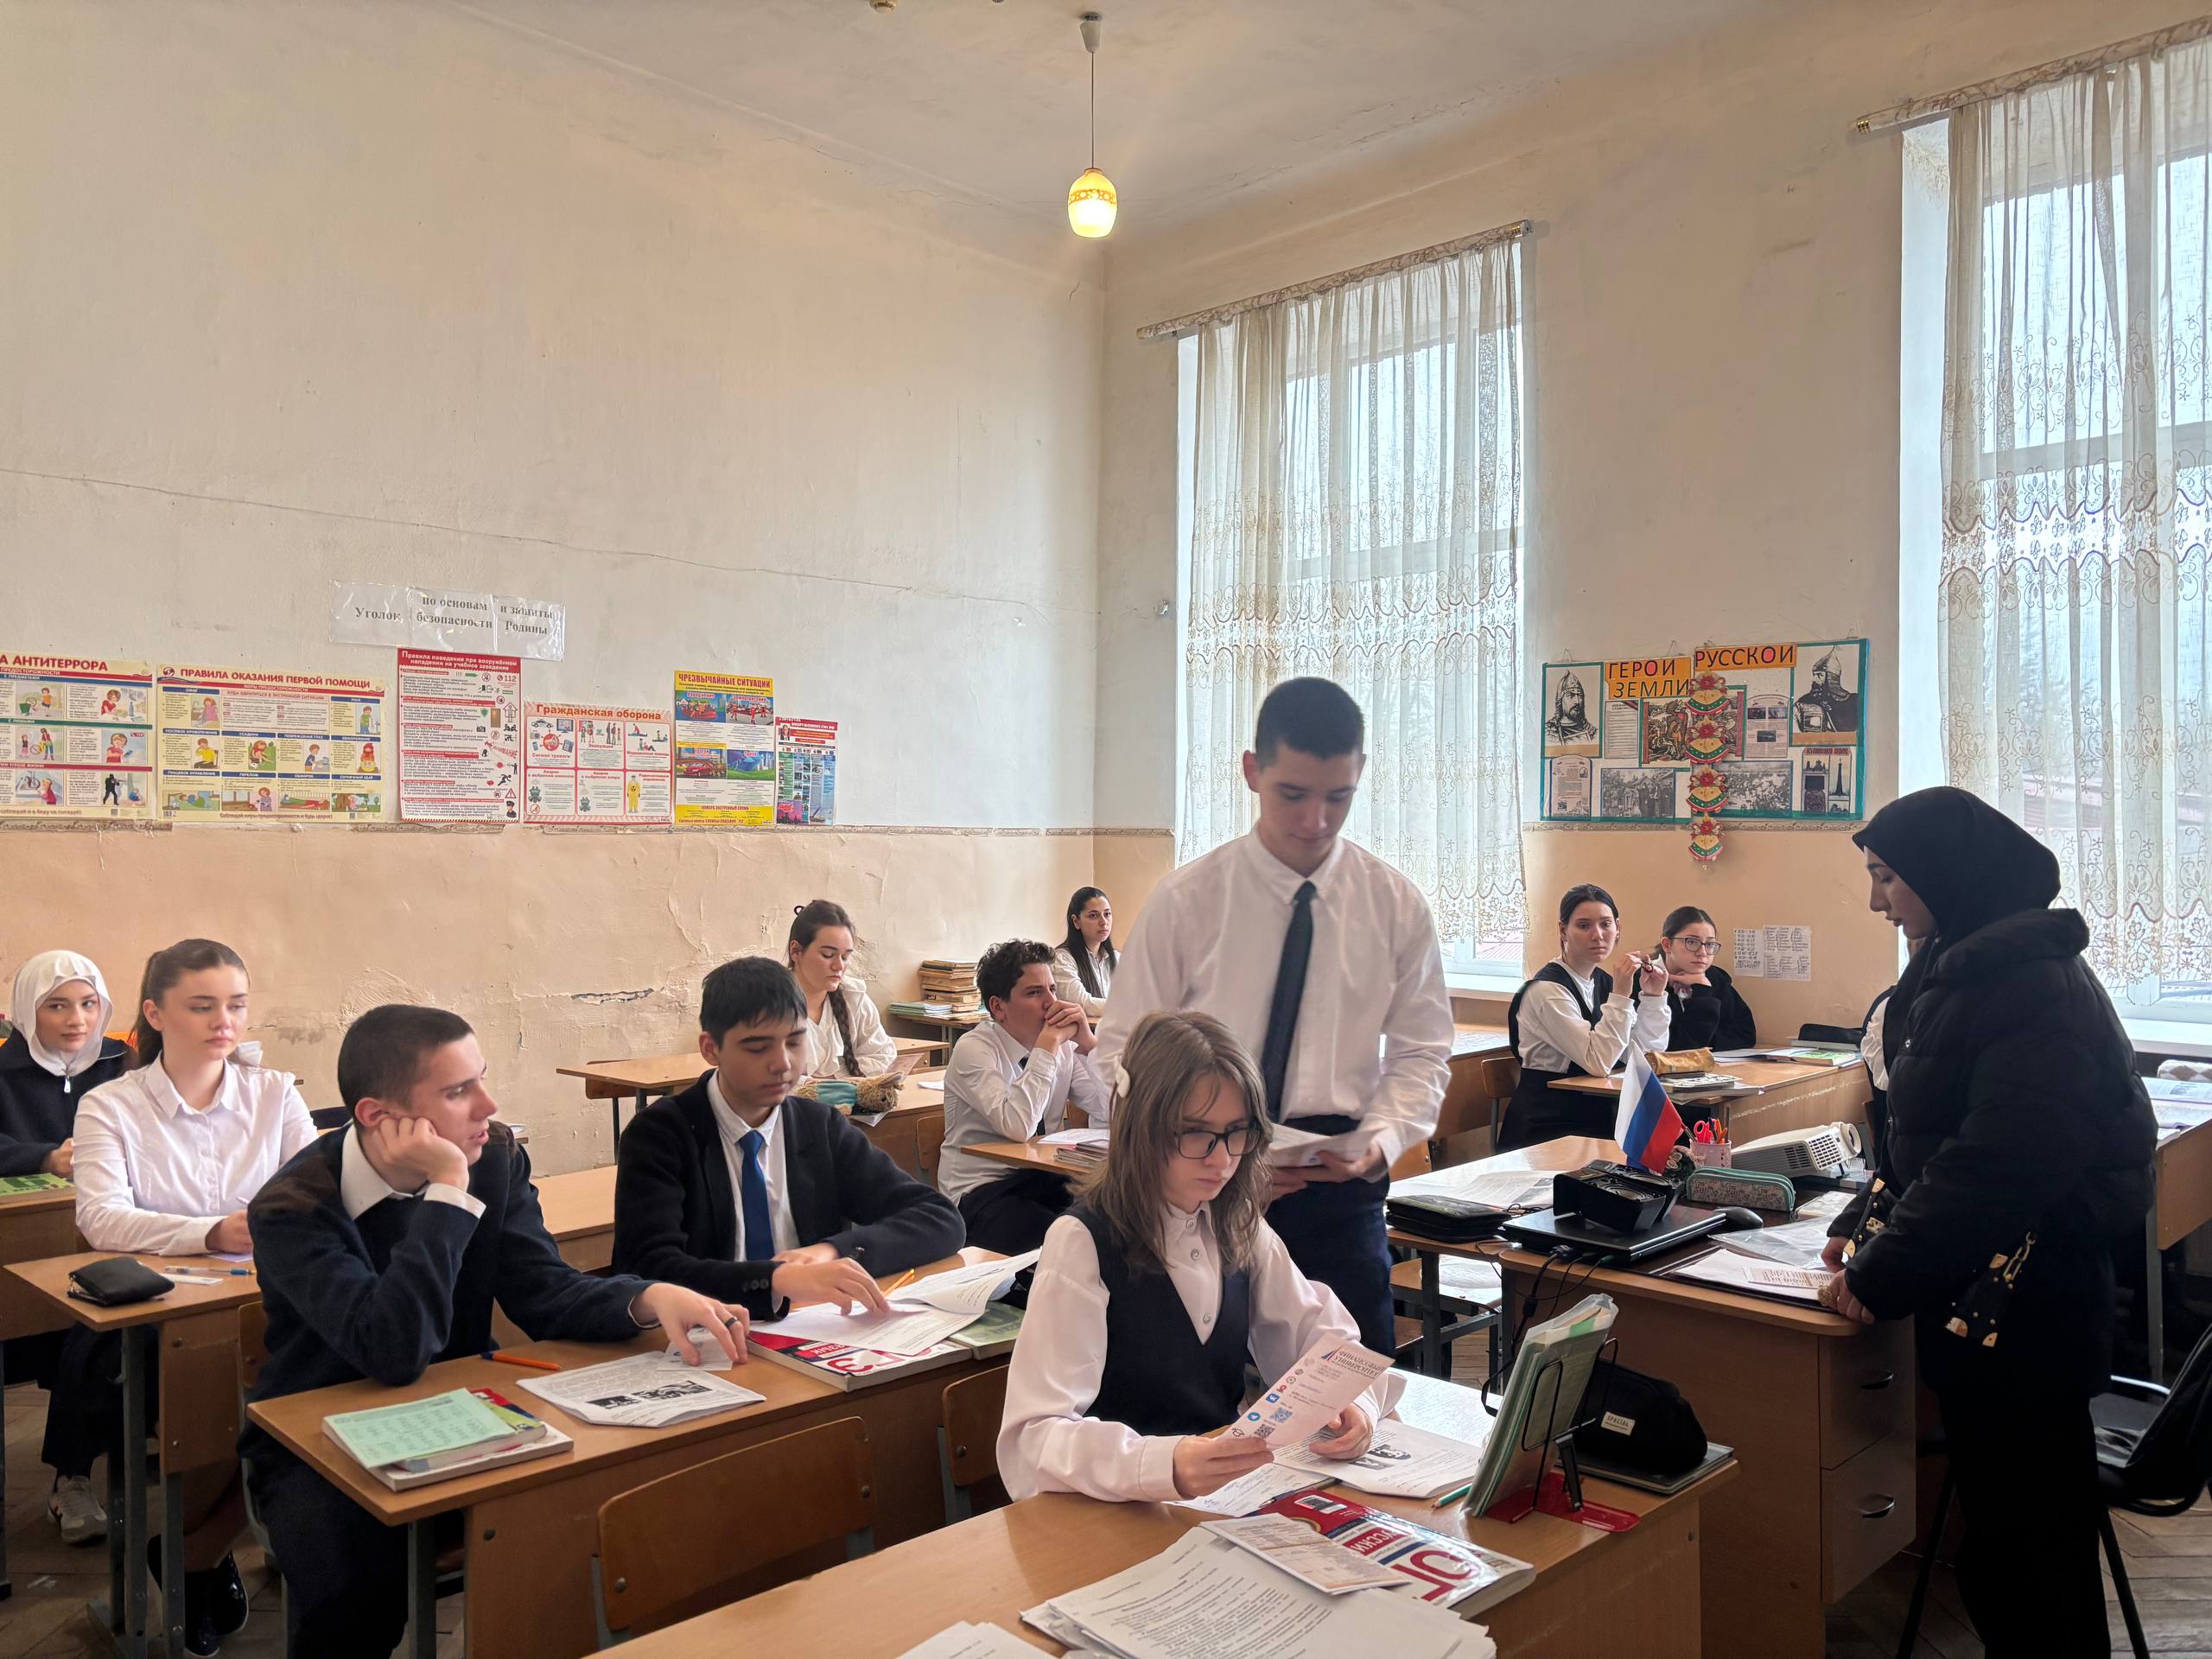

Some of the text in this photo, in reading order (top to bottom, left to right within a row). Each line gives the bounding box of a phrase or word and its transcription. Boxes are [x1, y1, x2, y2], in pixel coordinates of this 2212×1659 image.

[422, 596, 487, 611] по основам
[499, 605, 507, 613] и
[355, 607, 402, 621] Уголок
[416, 611, 493, 629] безопасности
[505, 620, 548, 635] Родины
[13, 655, 108, 671] АНТИТЕРРОРА
[402, 650, 430, 660] Правила
[1608, 659, 1675, 679] ГЕРОИ
[180, 669, 371, 689] ПРАВИЛА ОКАЗАНИЯ ПЕРВОЙ ПОМОЩИ
[678, 673, 735, 686] ЧРЕЗВЫЧАЙНЫЕ
[737, 678, 771, 689] СИТУАЦИИ
[1613, 678, 1689, 698] ЗЕМЛИ
[536, 704, 662, 721] Гражданская оборона
